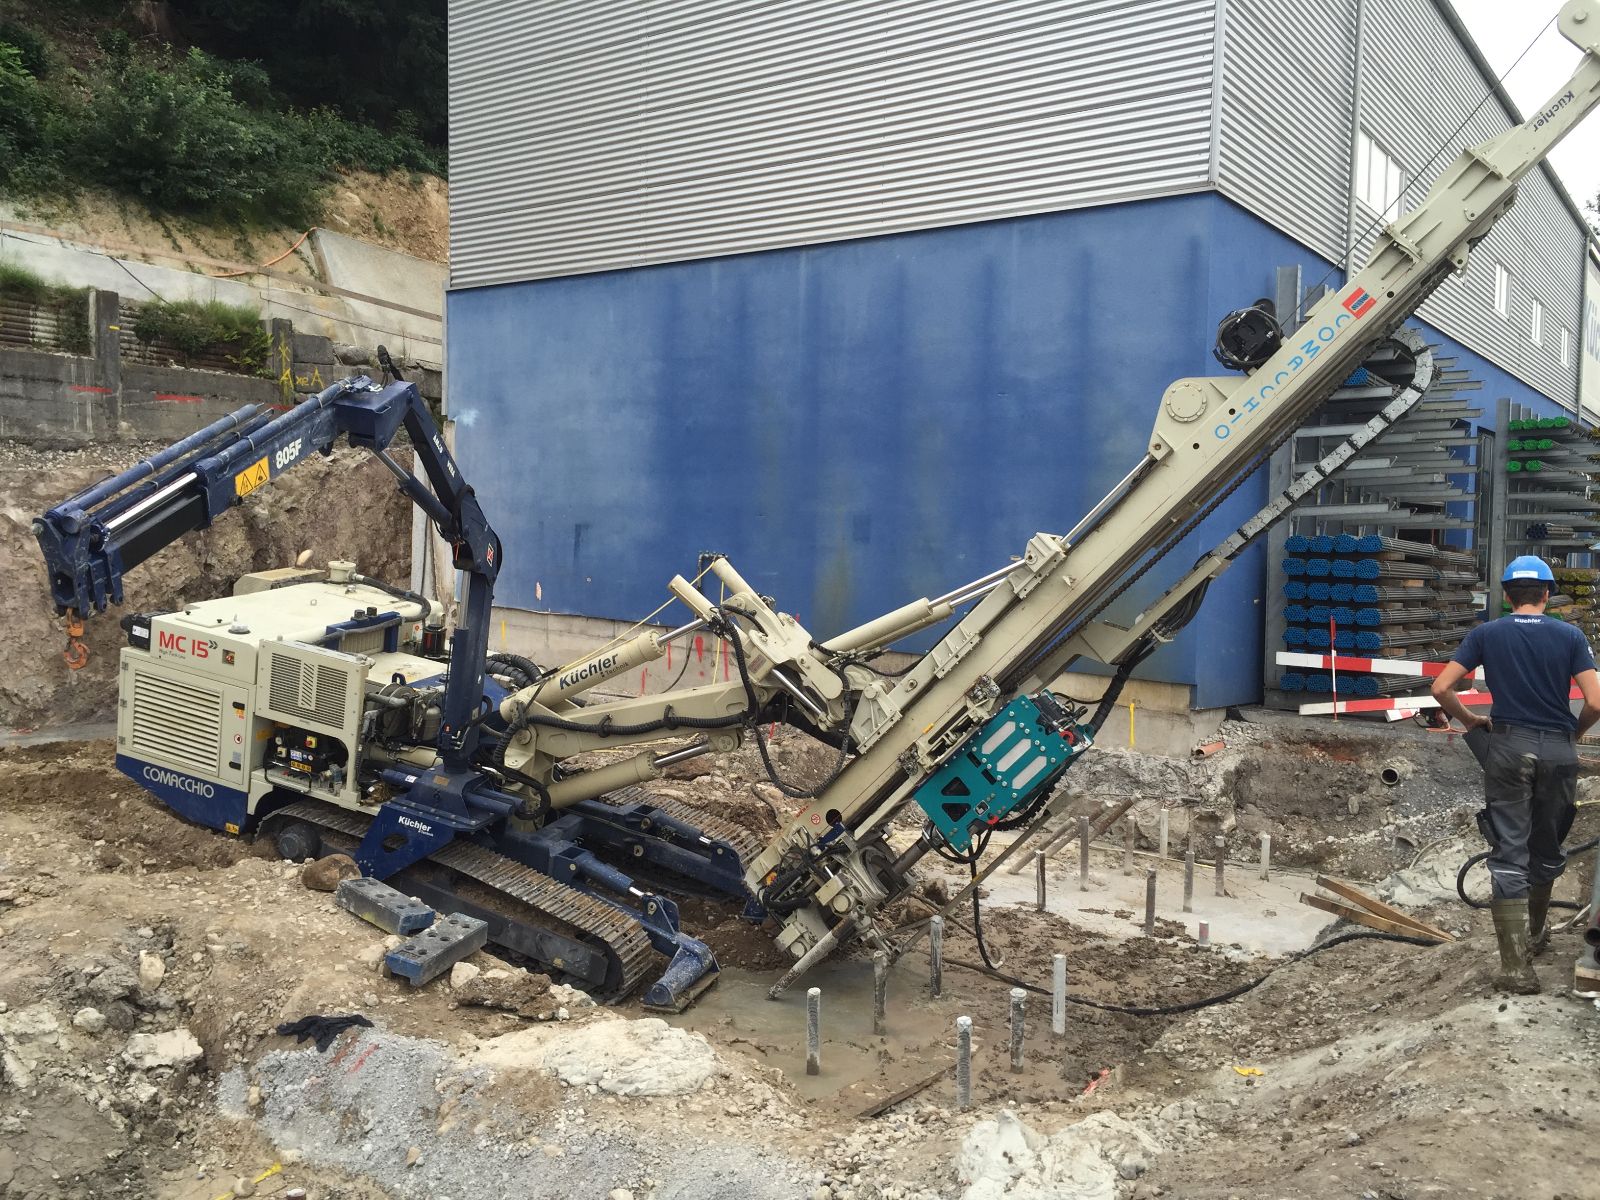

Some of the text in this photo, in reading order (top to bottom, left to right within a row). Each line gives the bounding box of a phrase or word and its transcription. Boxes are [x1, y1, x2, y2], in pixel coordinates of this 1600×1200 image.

[1533, 90, 1575, 132] Küchler
[1215, 313, 1350, 440] COMACCHIO
[275, 438, 303, 470] 805F
[159, 630, 187, 653] MC
[191, 638, 209, 660] 15
[559, 652, 619, 691] Küchler
[143, 765, 215, 799] COMACCHIO
[398, 815, 432, 833] Küchler
